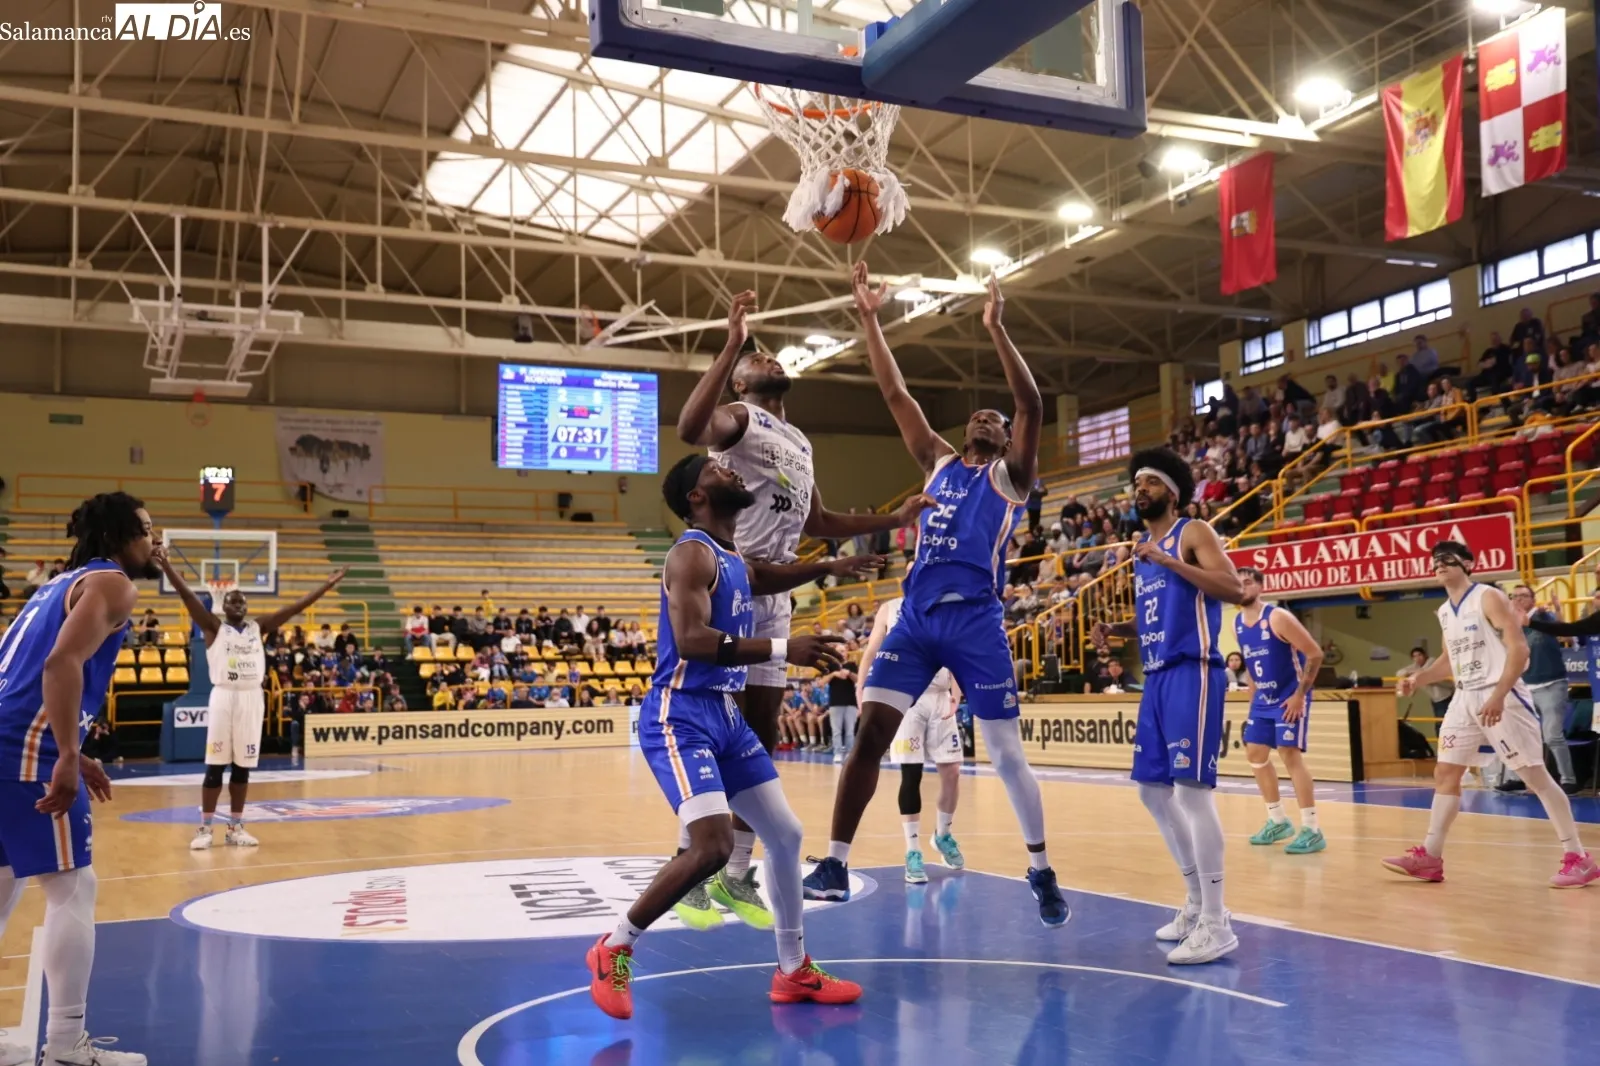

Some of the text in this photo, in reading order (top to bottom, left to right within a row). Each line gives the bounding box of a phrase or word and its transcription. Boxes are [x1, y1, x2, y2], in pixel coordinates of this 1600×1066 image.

[556, 425, 602, 443] 07:31
[212, 483, 226, 501] 7
[927, 503, 958, 529] 25
[1253, 524, 1468, 571] SALAMANCA
[1262, 548, 1506, 591] IMONIO DE LA HUMAAD
[1144, 596, 1159, 625] 22
[0, 606, 40, 673] 1
[875, 651, 899, 662] yrsa
[1254, 660, 1263, 677] 6
[313, 718, 614, 745] www.pansandcompany.com
[952, 734, 958, 748] 5
[246, 743, 256, 754] 15
